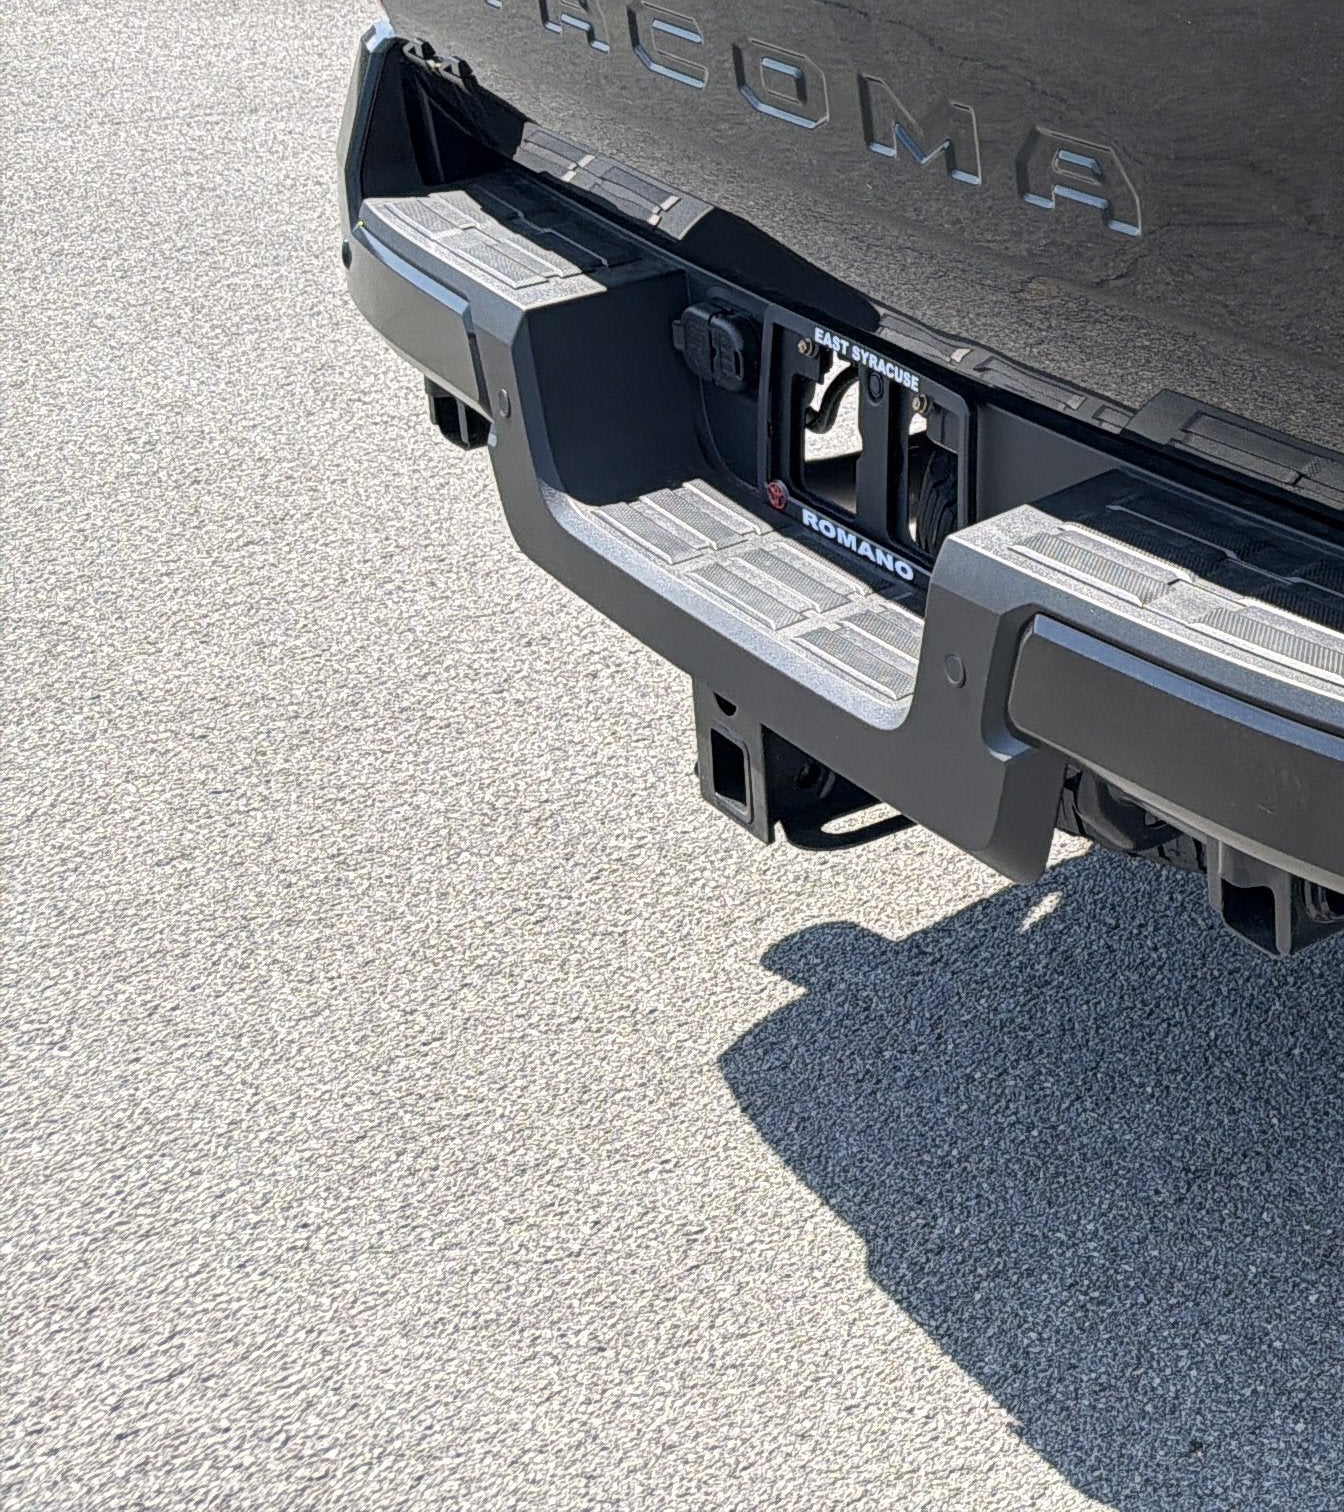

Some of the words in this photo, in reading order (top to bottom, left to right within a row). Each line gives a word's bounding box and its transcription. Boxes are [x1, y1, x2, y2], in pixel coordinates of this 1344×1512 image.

[814, 327, 850, 356] EAST
[851, 344, 920, 392] SYRACUSE
[802, 508, 915, 582] ROMANO
